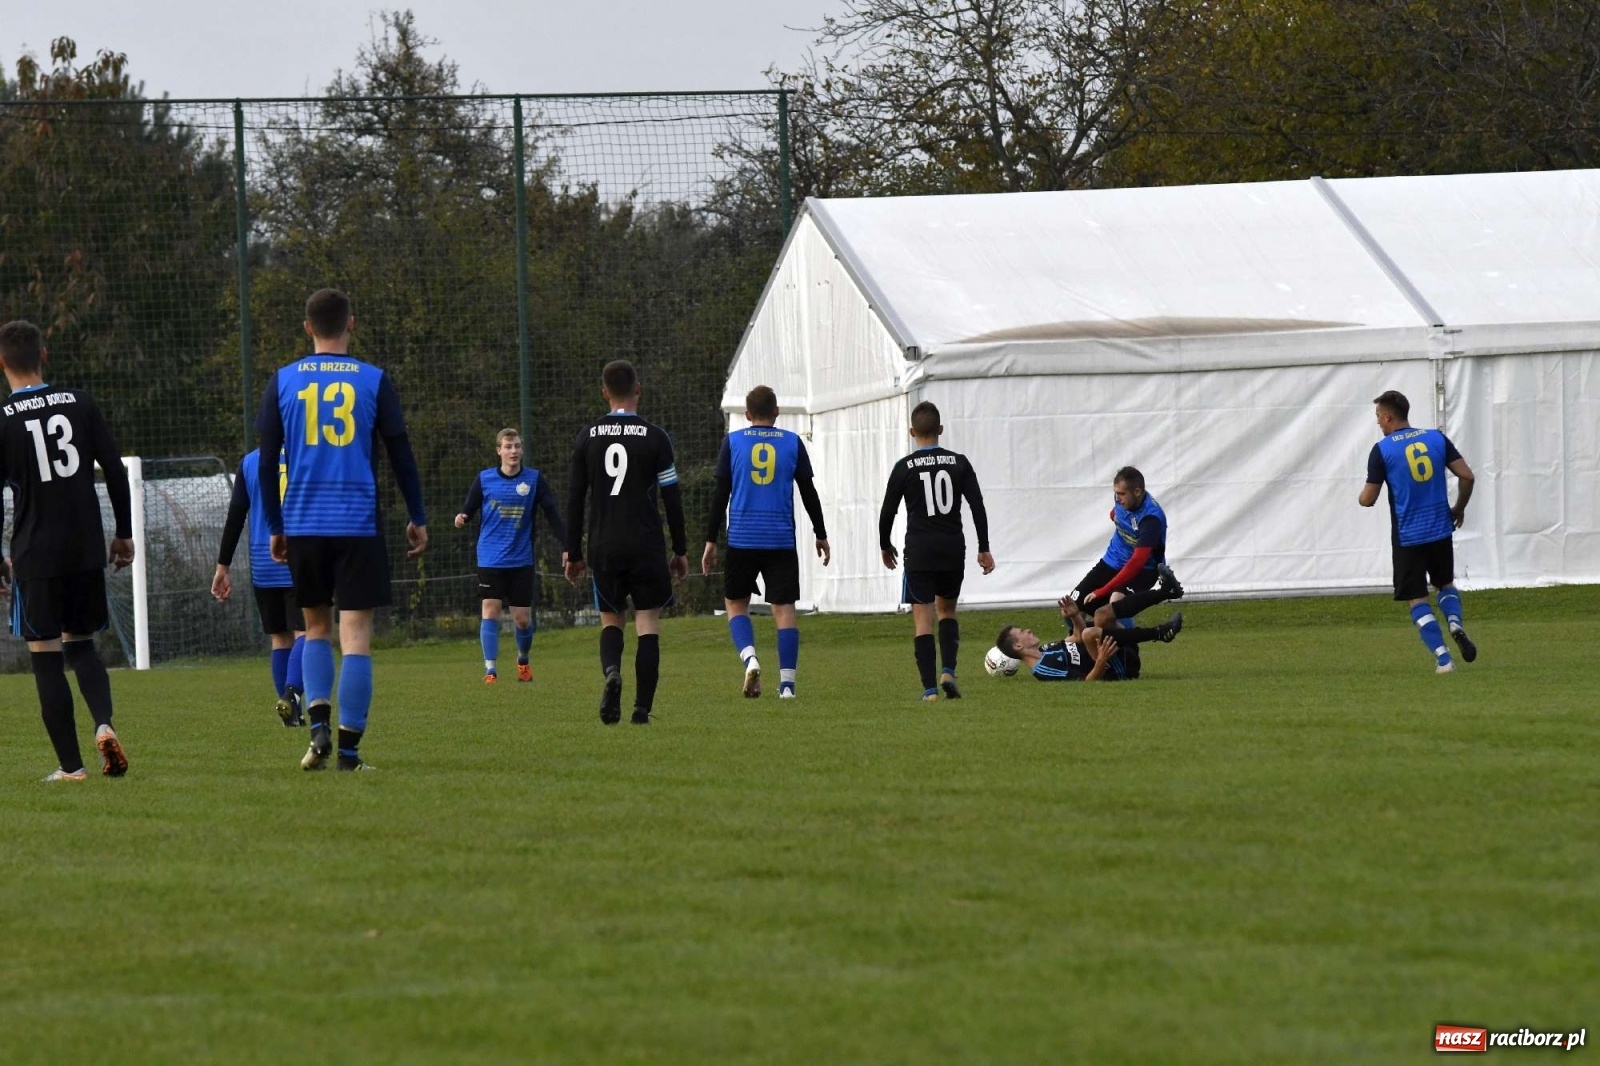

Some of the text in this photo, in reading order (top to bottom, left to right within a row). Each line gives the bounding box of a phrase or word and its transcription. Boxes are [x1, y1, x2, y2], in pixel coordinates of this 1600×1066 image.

[297, 362, 360, 373] LKS BRZEZIE
[3, 392, 77, 416] KS NAPRZÓD BORUCIN
[297, 382, 356, 447] 13
[24, 413, 80, 482] 13
[604, 442, 628, 496] 9
[751, 442, 776, 485] 9
[1405, 441, 1434, 482] 6
[919, 469, 954, 517] 10
